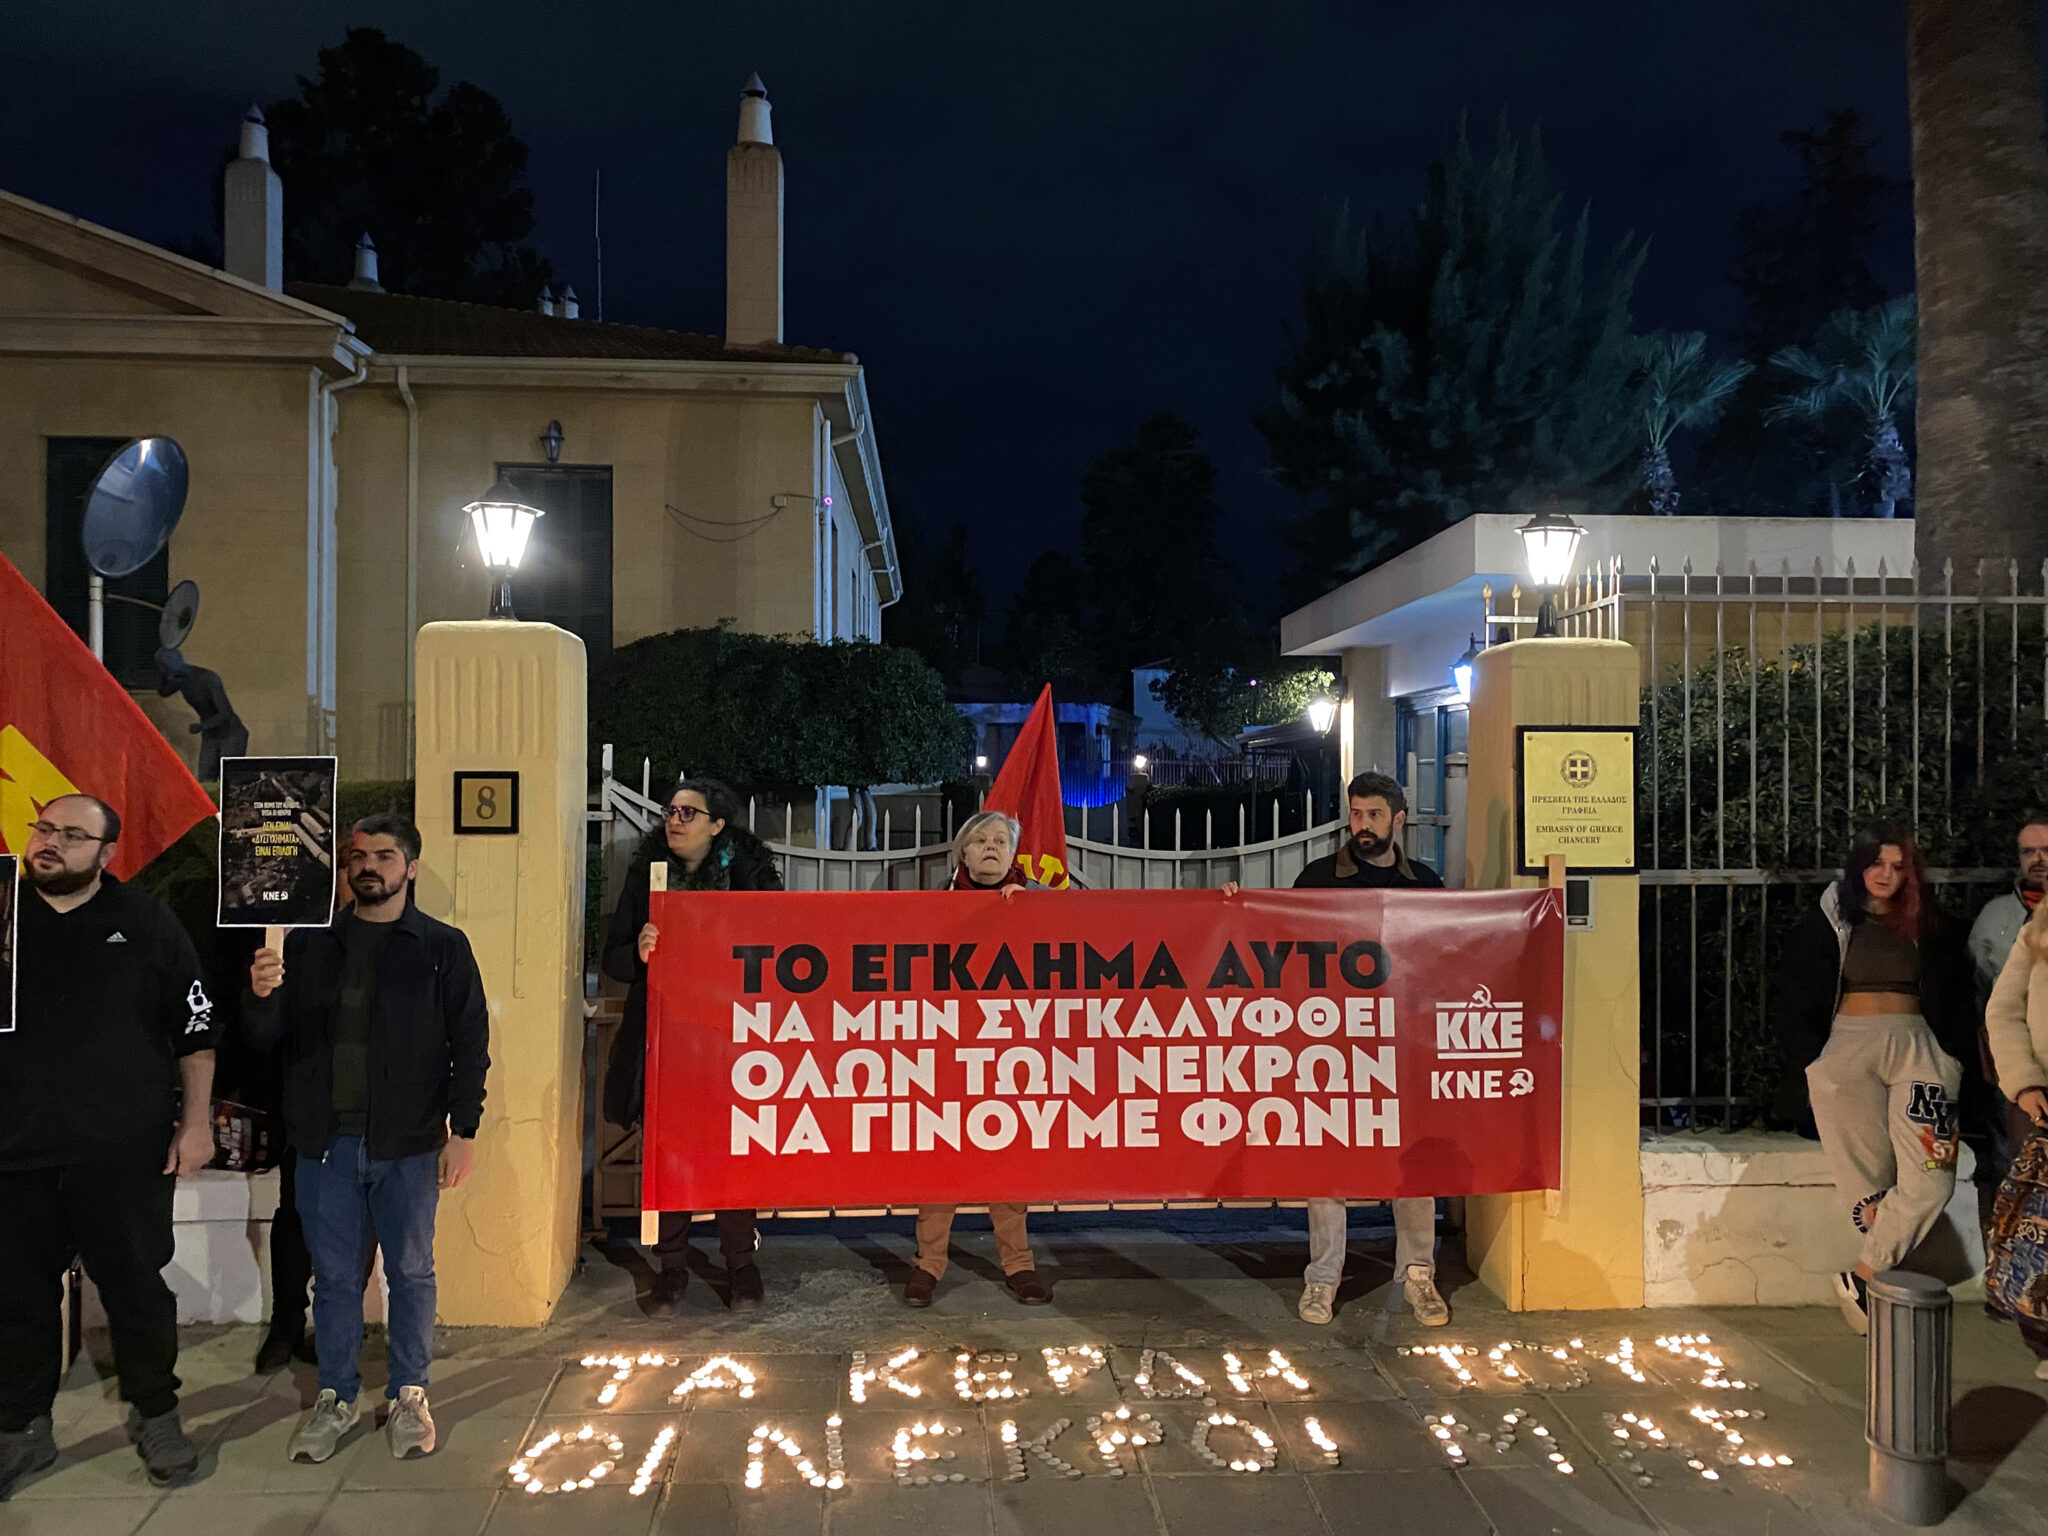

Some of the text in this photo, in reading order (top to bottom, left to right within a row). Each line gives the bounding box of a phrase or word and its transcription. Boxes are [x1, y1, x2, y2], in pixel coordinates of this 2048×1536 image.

[476, 785, 497, 820] 8
[1532, 796, 1627, 804] ΠΡΕΣΒΕΙΑ ΤΗΣ ΕΛΛΑΔΟΣ
[1562, 807, 1597, 815] ΓΡΑΦΕΙΑ
[1536, 825, 1623, 833] EMBASSY OF GREECE
[1558, 836, 1601, 844] CHANCERY
[732, 940, 1392, 994] ΤΟ ΕΓΚΛΗΜΑ ΑΥΤΟ
[732, 996, 1395, 1043] ΝΑ ΜΗΝ ΣΥΓΚΑΛΥΦΘΕΙ
[1436, 1011, 1523, 1050] ΚΚΕ
[731, 1044, 1397, 1100] ΟΛΩΝ ΤΩΝ ΝΕΚΡΩΝ
[1431, 1070, 1503, 1099] ΚΝΕ
[731, 1097, 1400, 1156] ΝΑ ΓΙΝΟΥΜΕ ΦΩΝΗ
[1907, 1081, 1958, 1138] NY
[580, 1354, 757, 1403] ΤΑ
[850, 1344, 1310, 1402] ΚΕΡΔΗ
[508, 1425, 677, 1496] ΟΙ
[744, 1403, 1340, 1490] ΝΕΚΡΟΙ
